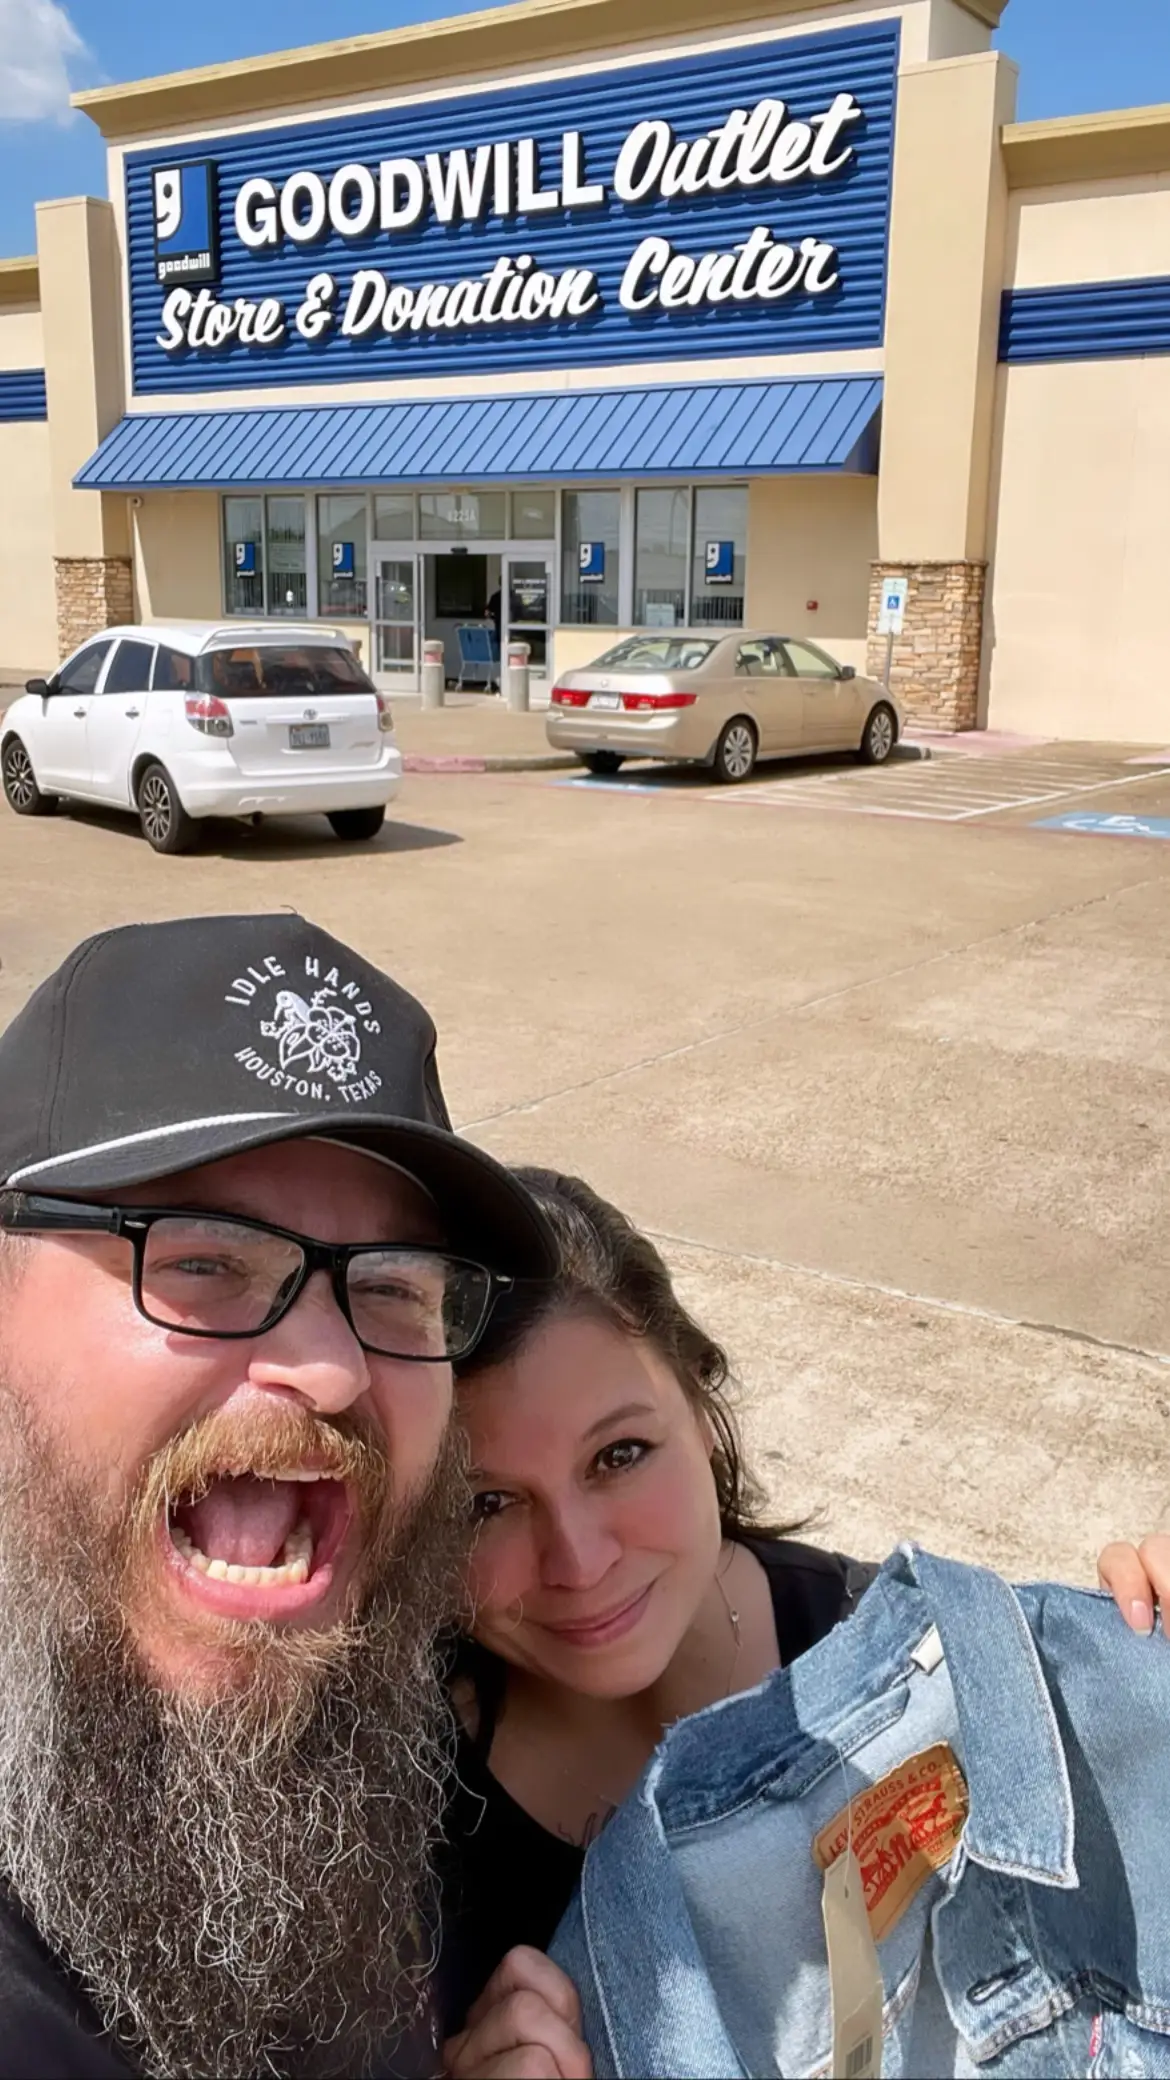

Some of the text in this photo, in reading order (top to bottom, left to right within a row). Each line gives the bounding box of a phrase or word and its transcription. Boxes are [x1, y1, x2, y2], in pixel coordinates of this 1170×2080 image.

[234, 92, 862, 247] GOODWILL Outlet
[156, 226, 839, 350] Store & Donation Center
[157, 252, 211, 280] goodwill
[224, 955, 382, 1036] IDLE HANDS
[337, 1069, 383, 1104] TEXAS
[853, 1779, 905, 1828] STRAUSS
[907, 1772, 918, 1785] &
